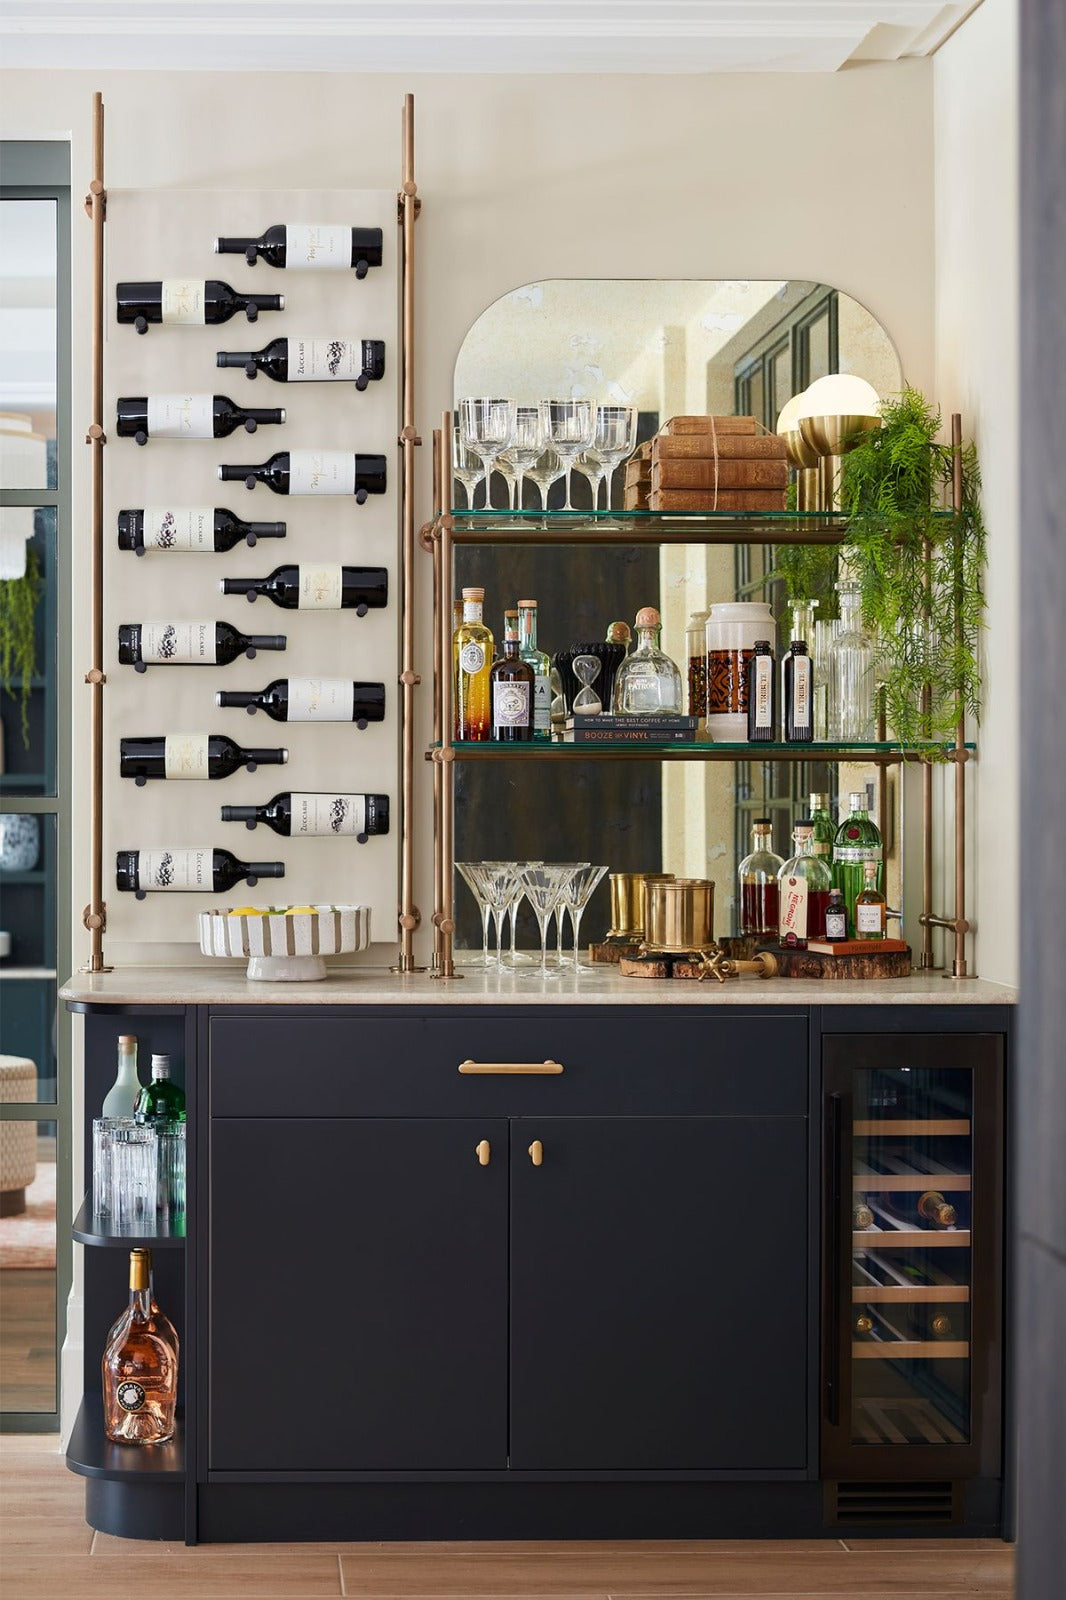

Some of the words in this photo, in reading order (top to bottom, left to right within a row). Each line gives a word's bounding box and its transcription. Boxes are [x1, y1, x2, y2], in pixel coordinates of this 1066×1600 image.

[297, 342, 305, 375] ZUCCARDI
[199, 625, 207, 656] ZUCCARDI
[584, 731, 613, 739] BOOZE
[623, 731, 649, 739] VINYL
[300, 800, 308, 832] ZUCCARDI
[196, 852, 204, 884] ZUCCARDI
[785, 894, 799, 927] NEGRONI
[118, 1384, 144, 1396] MIRAVAL
